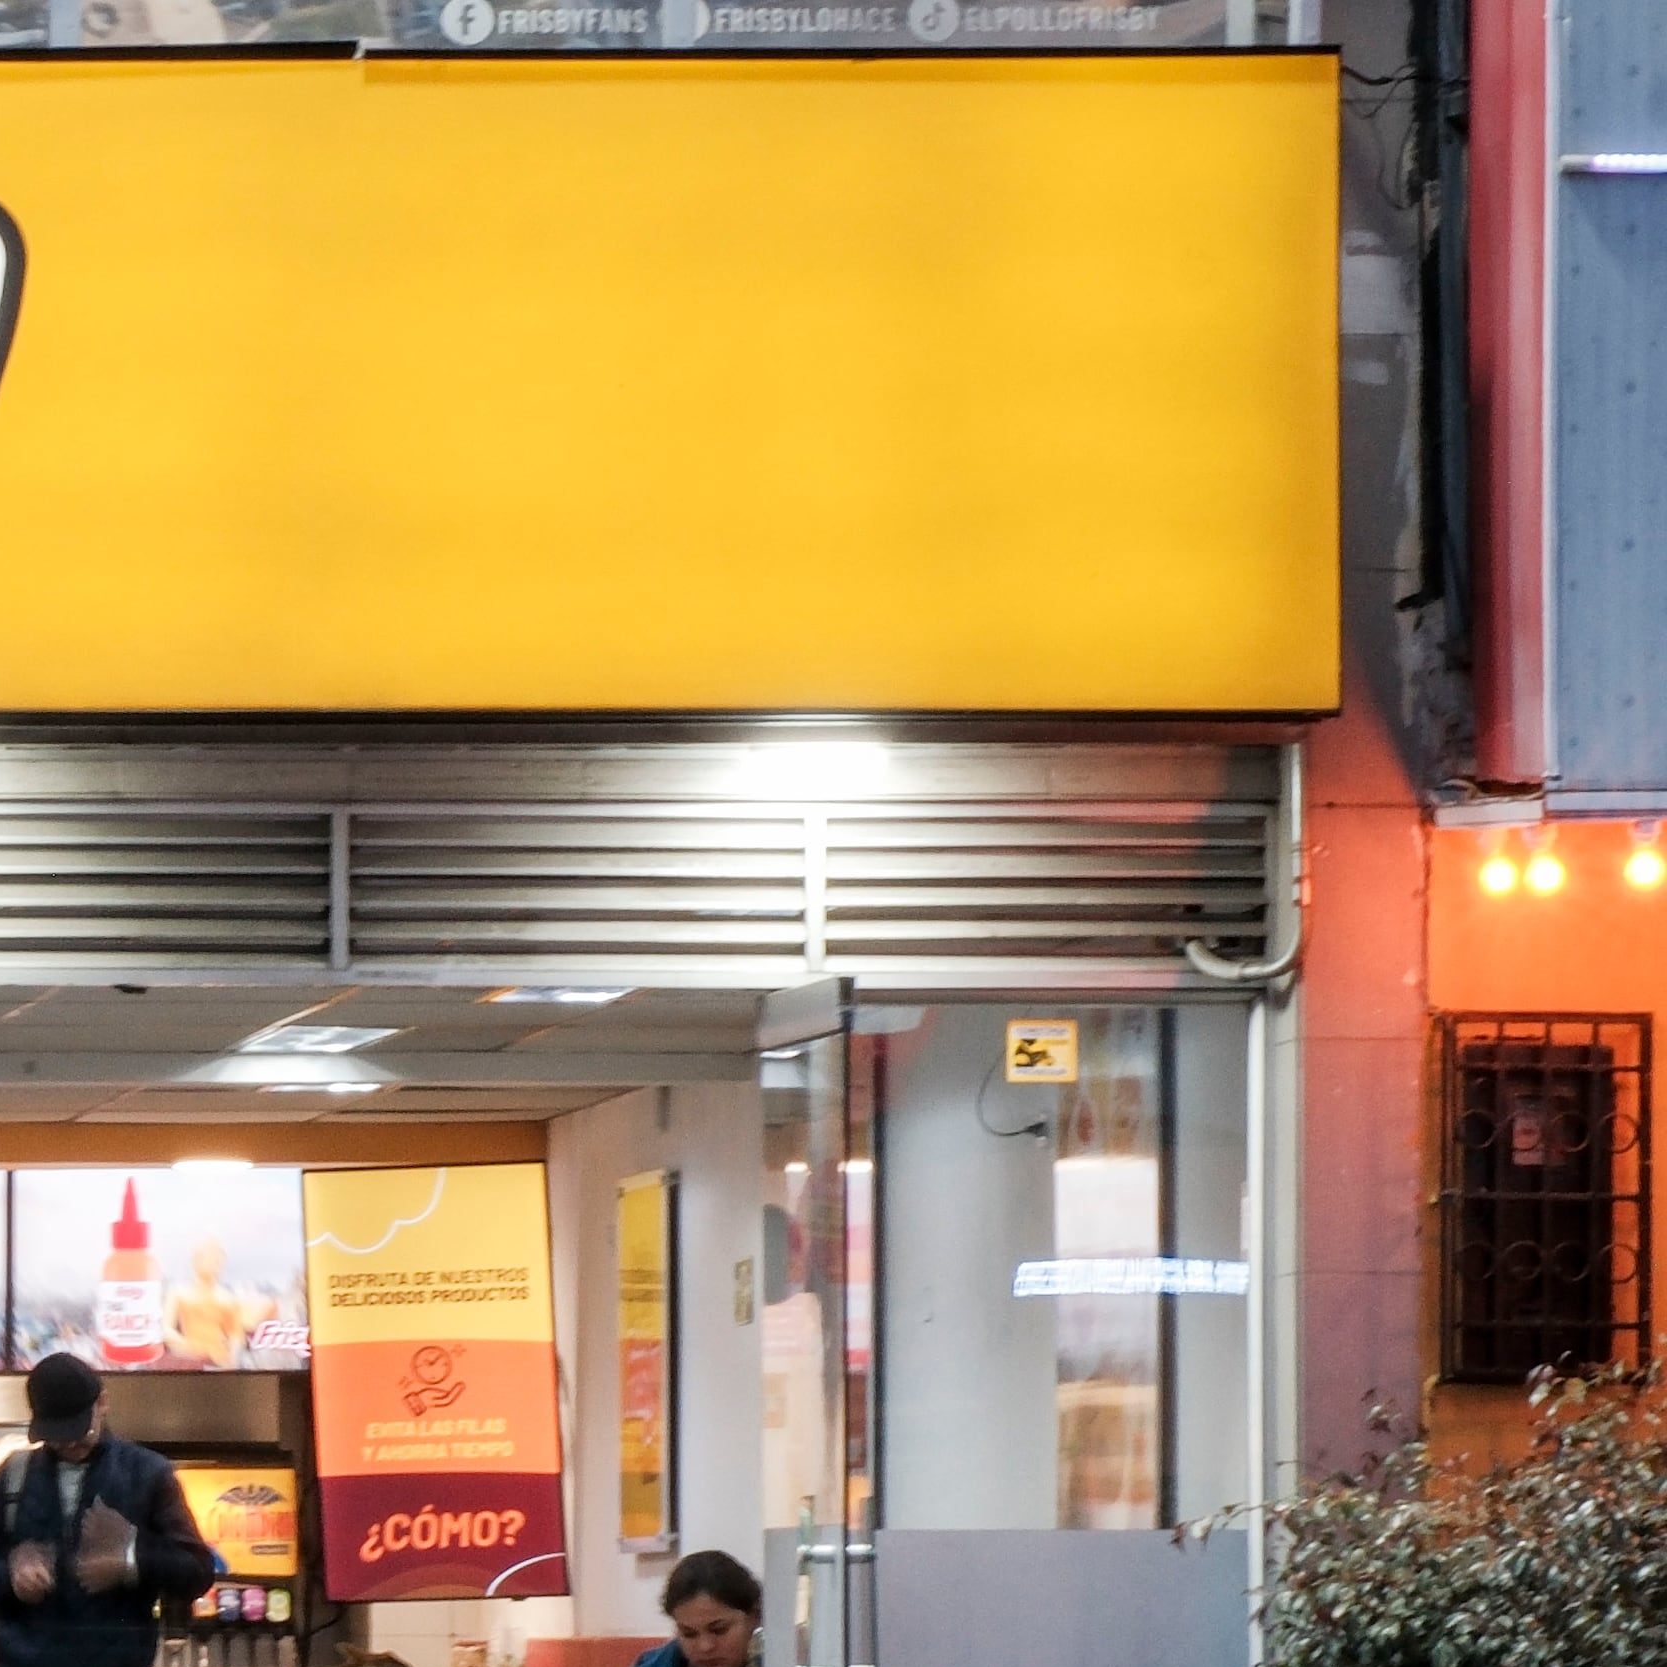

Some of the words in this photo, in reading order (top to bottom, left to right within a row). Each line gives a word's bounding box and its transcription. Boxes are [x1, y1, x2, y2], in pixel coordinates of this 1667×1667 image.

[497, 7, 649, 35] FRISBYFANS
[329, 1272, 410, 1289] DISFRUTA
[414, 1270, 435, 1286] DE
[440, 1267, 530, 1285] NUESTROS
[330, 1290, 427, 1308] DELICIOSOS
[431, 1286, 530, 1304] PRODUCTOS
[358, 1503, 526, 1563] ¿CÓMO?
